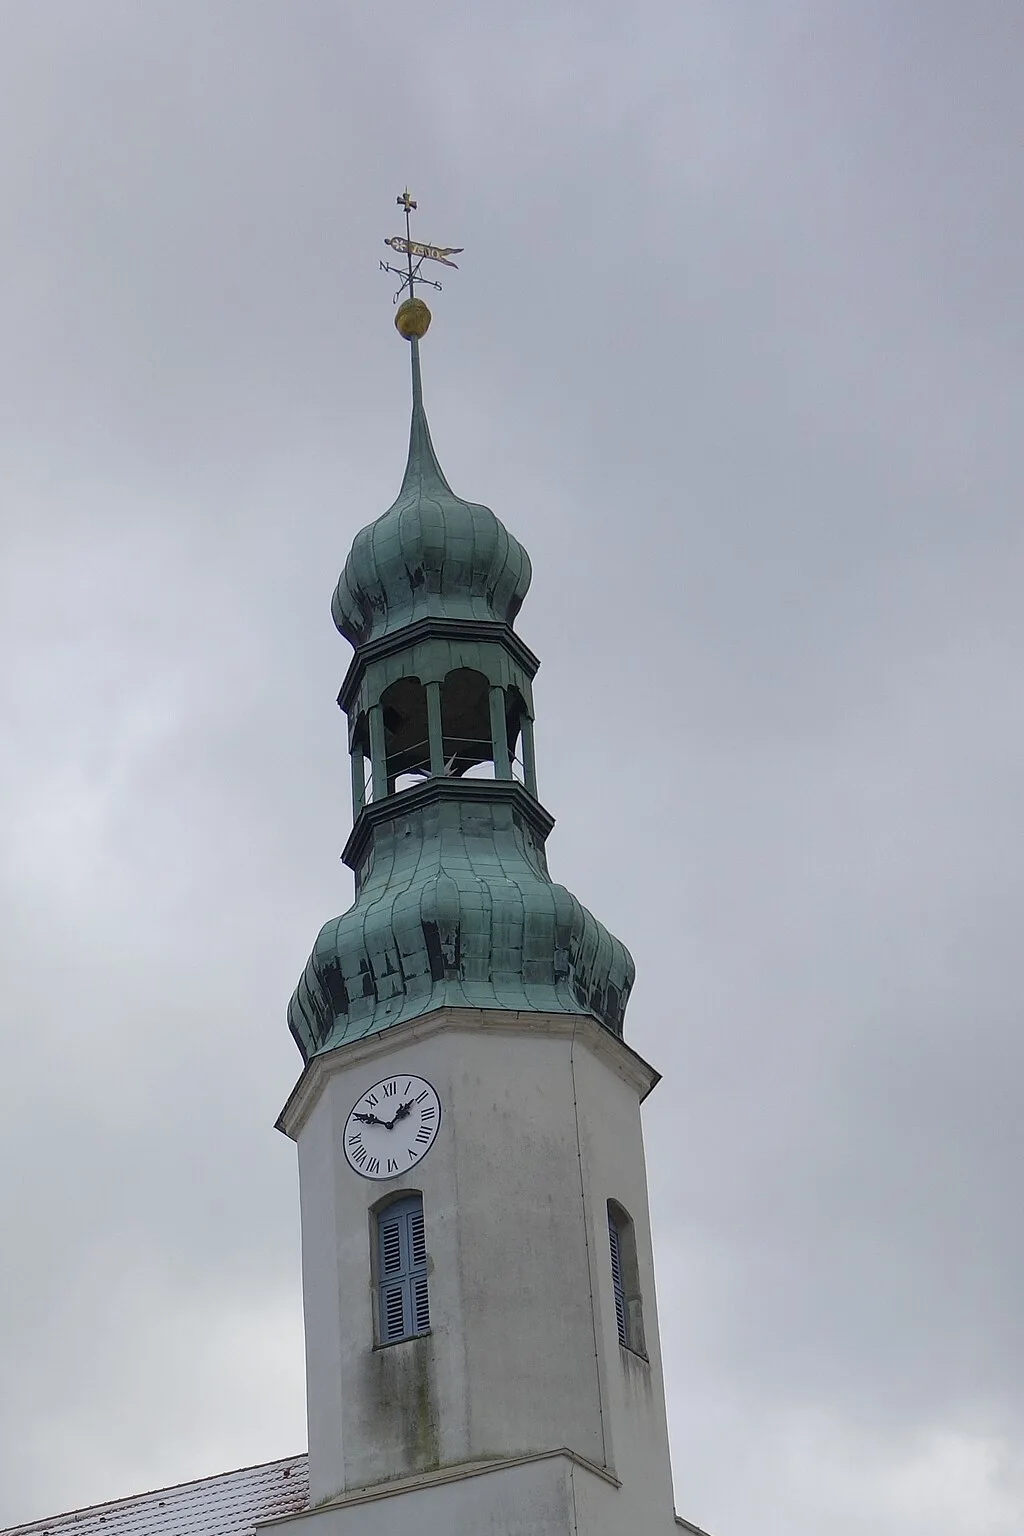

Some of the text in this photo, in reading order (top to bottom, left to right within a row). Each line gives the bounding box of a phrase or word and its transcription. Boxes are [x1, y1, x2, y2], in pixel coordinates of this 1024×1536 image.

[379, 260, 389, 272] N
[383, 1081, 396, 1098] XII
[415, 1090, 429, 1104] II
[365, 1094, 378, 1109] XI
[421, 1107, 435, 1122] III
[349, 1132, 361, 1145] IX
[415, 1126, 433, 1143] IIII
[352, 1144, 367, 1167] VIII
[408, 1148, 417, 1160] V
[366, 1157, 380, 1173] VII
[388, 1158, 398, 1172] VI
